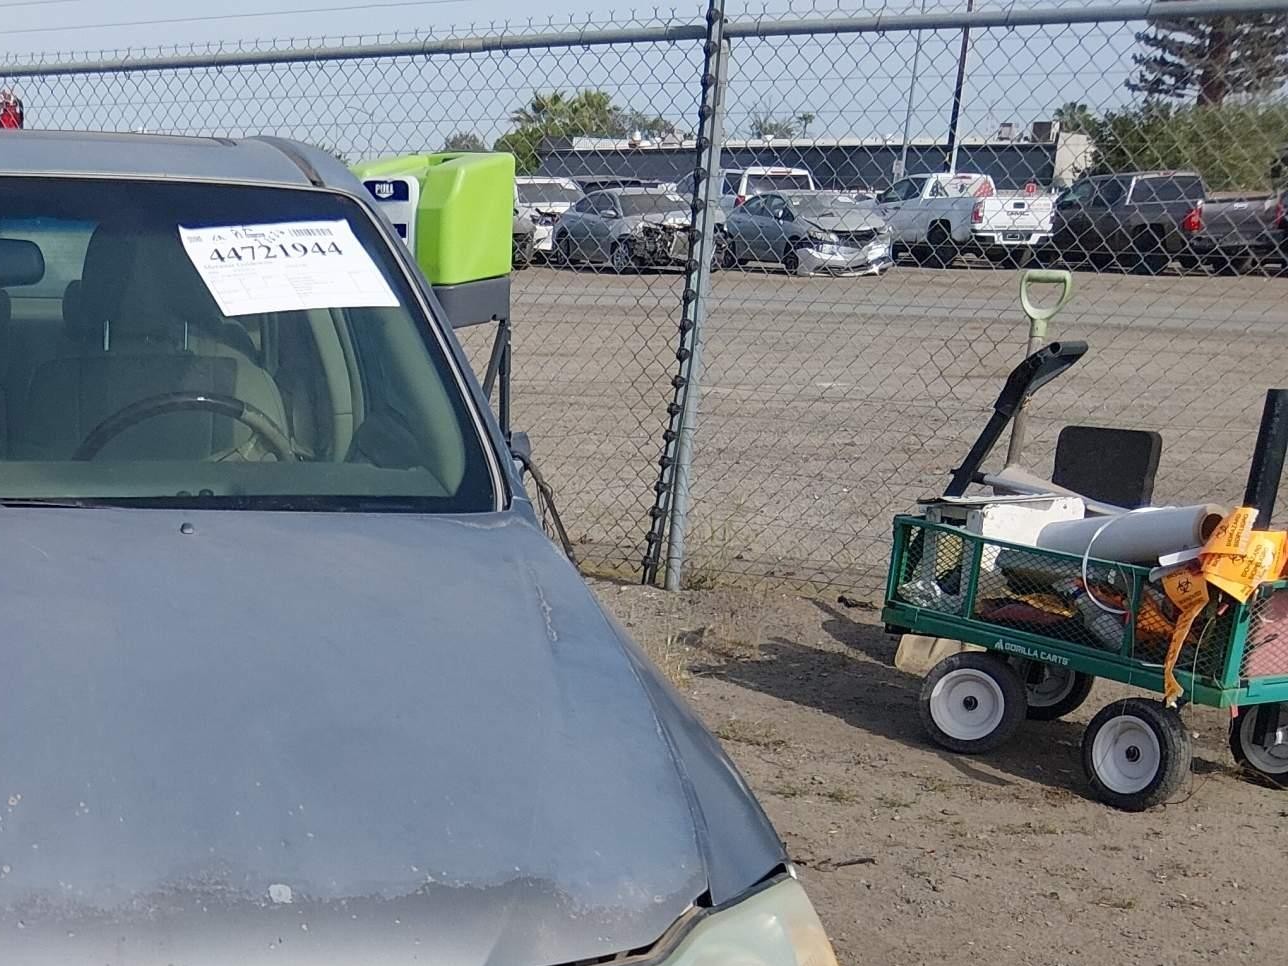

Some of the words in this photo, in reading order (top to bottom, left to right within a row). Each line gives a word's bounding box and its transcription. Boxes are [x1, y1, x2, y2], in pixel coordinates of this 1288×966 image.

[210, 241, 343, 262] 44721944
[1004, 642, 1039, 658] GORILLA
[1040, 651, 1069, 665] CARTS
